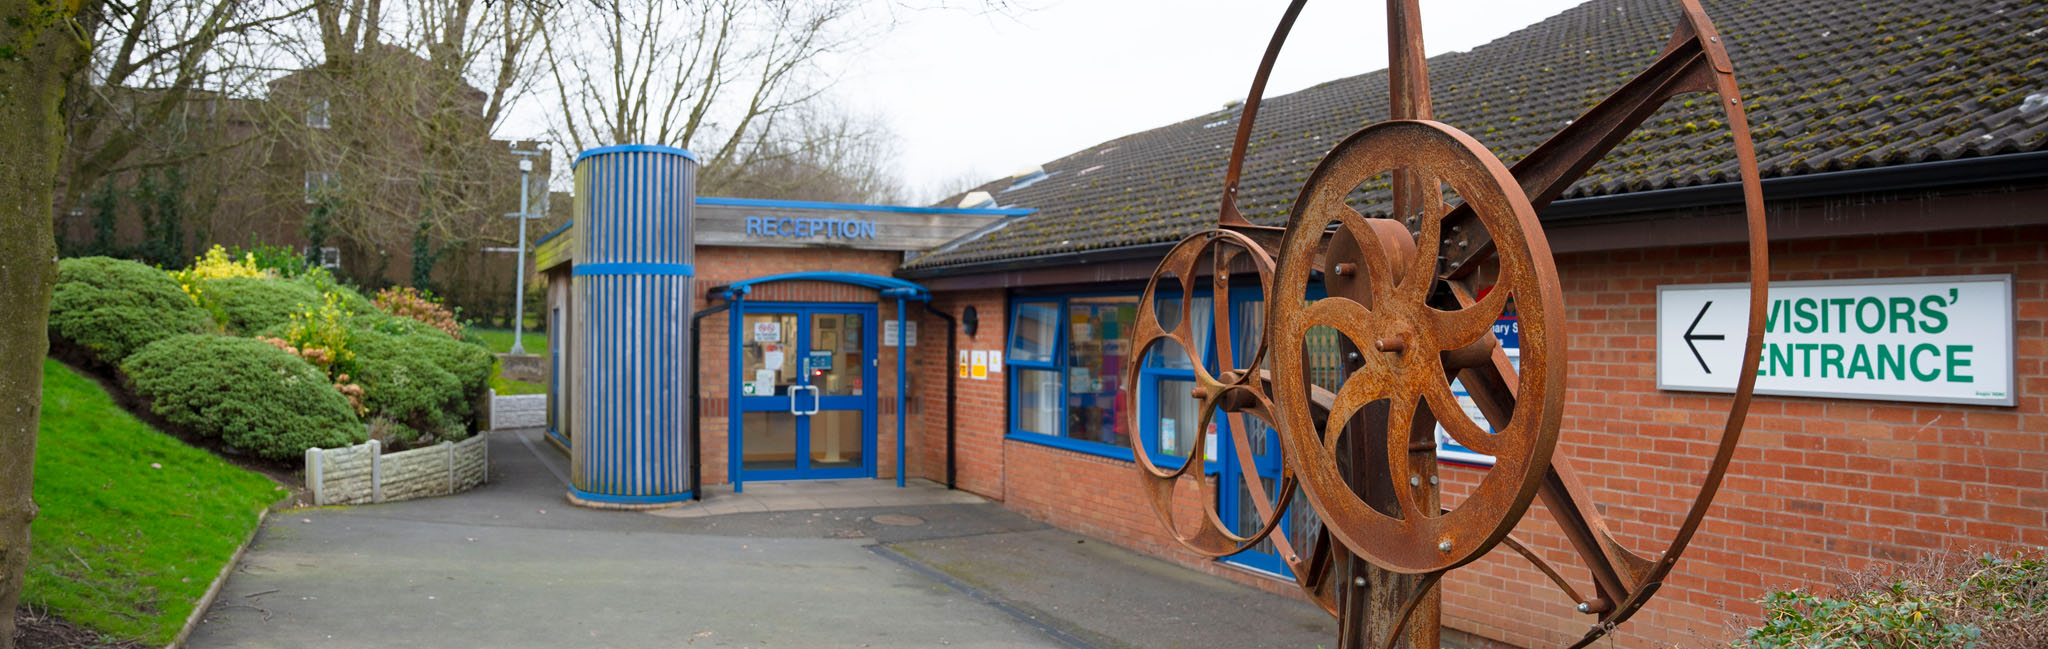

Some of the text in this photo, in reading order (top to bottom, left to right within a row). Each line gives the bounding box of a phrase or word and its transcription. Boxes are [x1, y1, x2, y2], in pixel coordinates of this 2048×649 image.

[746, 215, 876, 239] RECEPTION
[1765, 288, 1958, 334] VISITORS'
[1491, 324, 1509, 335] ary
[1757, 343, 1974, 383] NTRANCE
